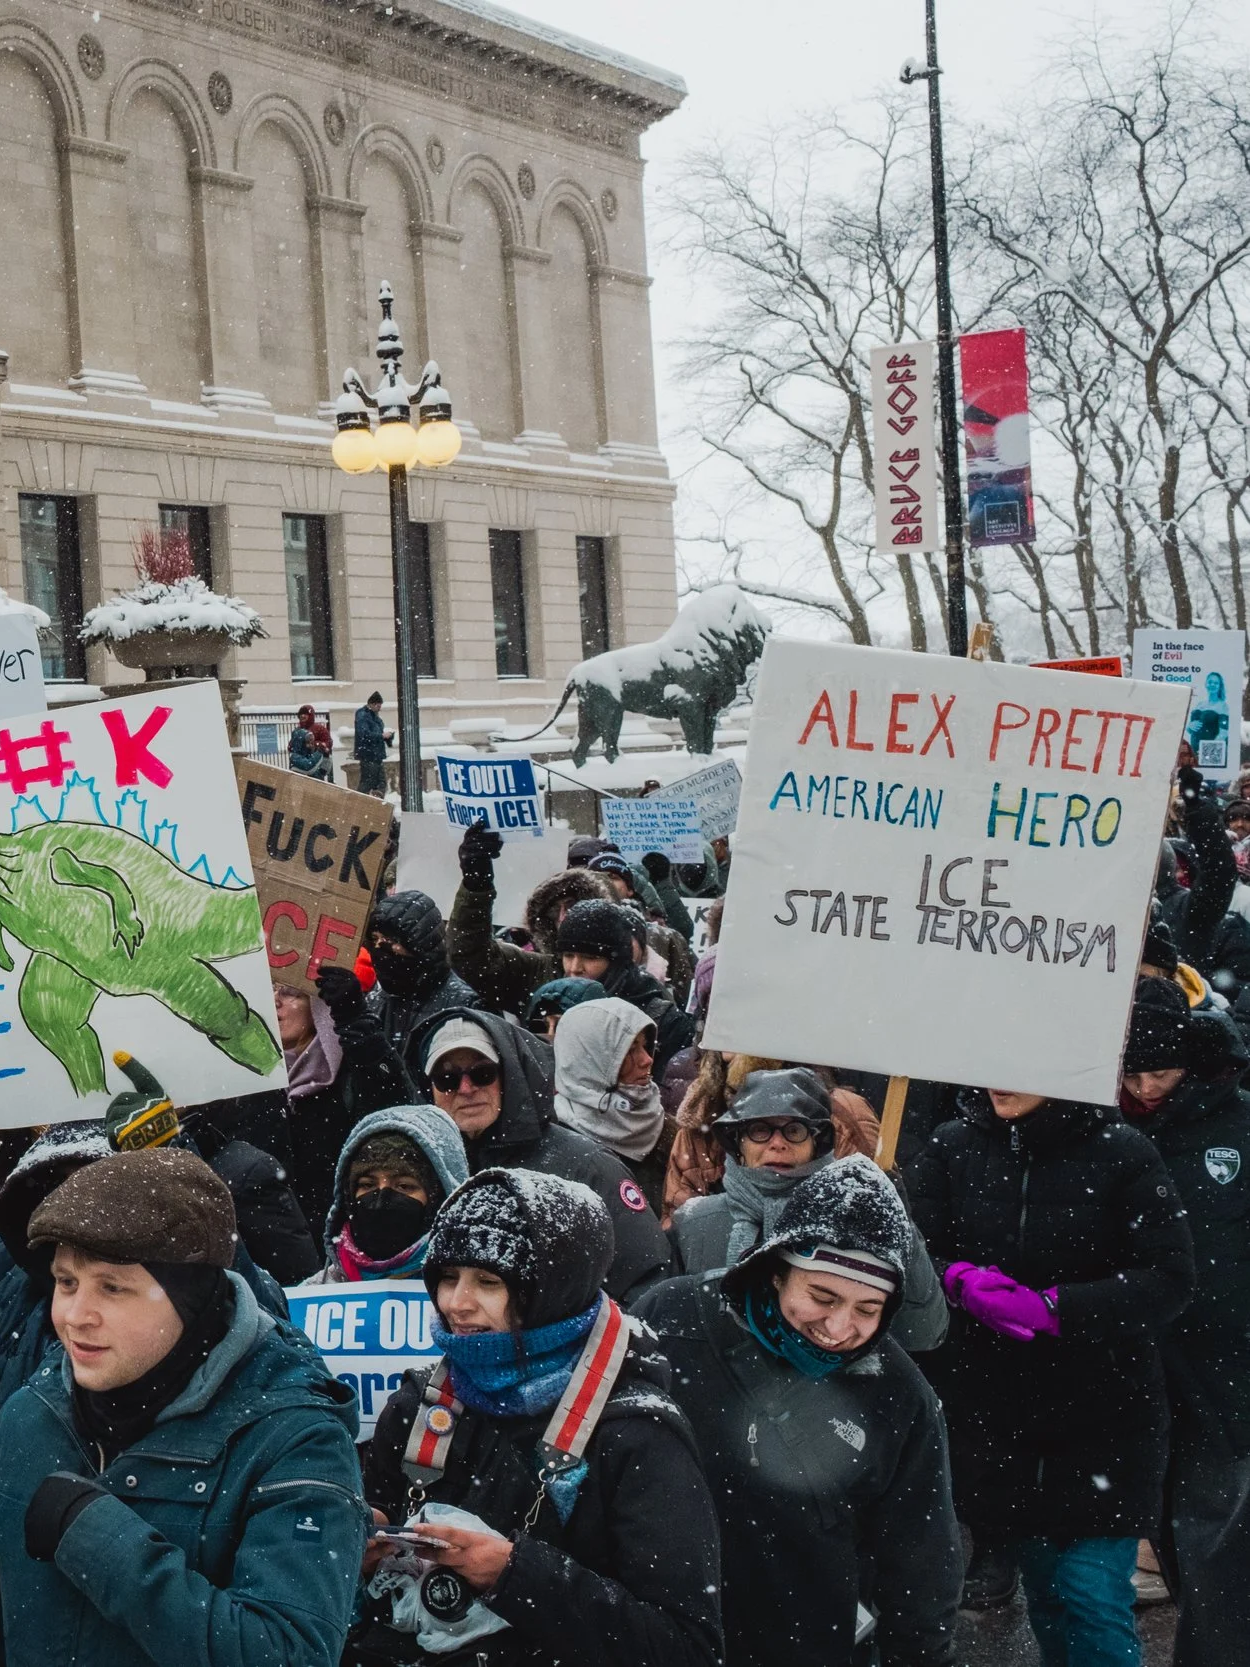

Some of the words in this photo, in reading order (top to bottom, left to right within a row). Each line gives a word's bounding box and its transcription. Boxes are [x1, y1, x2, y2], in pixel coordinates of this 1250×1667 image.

[210, 2, 277, 34] HOLBEIN
[886, 353, 918, 436] GOFF
[888, 448, 922, 545] BRUCE
[1152, 642, 1163, 650] In
[1165, 642, 1182, 651] the
[1183, 643, 1204, 651] face
[1152, 652, 1163, 660] of
[1164, 652, 1183, 660] Evil
[1151, 664, 1189, 673] Choose
[1191, 665, 1201, 673] to
[1151, 674, 1164, 682] be
[1165, 674, 1192, 683] Good
[796, 690, 957, 759] ALEX
[988, 702, 1156, 778] PRETTI
[445, 762, 468, 794] ICE
[467, 764, 517, 795] OUT!
[493, 799, 539, 829] ICE!
[606, 801, 631, 811] THEY
[634, 802, 652, 811] DID
[655, 801, 677, 810] THIS
[689, 800, 696, 809] A
[606, 812, 637, 821] WHITE
[639, 812, 657, 820] MAN
[659, 811, 669, 820] IN
[671, 810, 699, 819] FRONT
[769, 771, 944, 830] AMERICAN
[986, 782, 1123, 848] HERO
[240, 780, 380, 891] FUCK
[609, 829, 633, 837] ABOUT
[644, 836, 677, 844] BEHIND
[663, 821, 687, 829] THINK
[620, 844, 641, 852] OSED
[918, 854, 1012, 909] ICE
[263, 901, 358, 981] CE
[773, 889, 891, 941] STATE
[916, 905, 1116, 973] TERRORISM
[1208, 1150, 1237, 1159] TESC
[304, 1301, 368, 1350] ICE
[379, 1298, 436, 1351] OU
